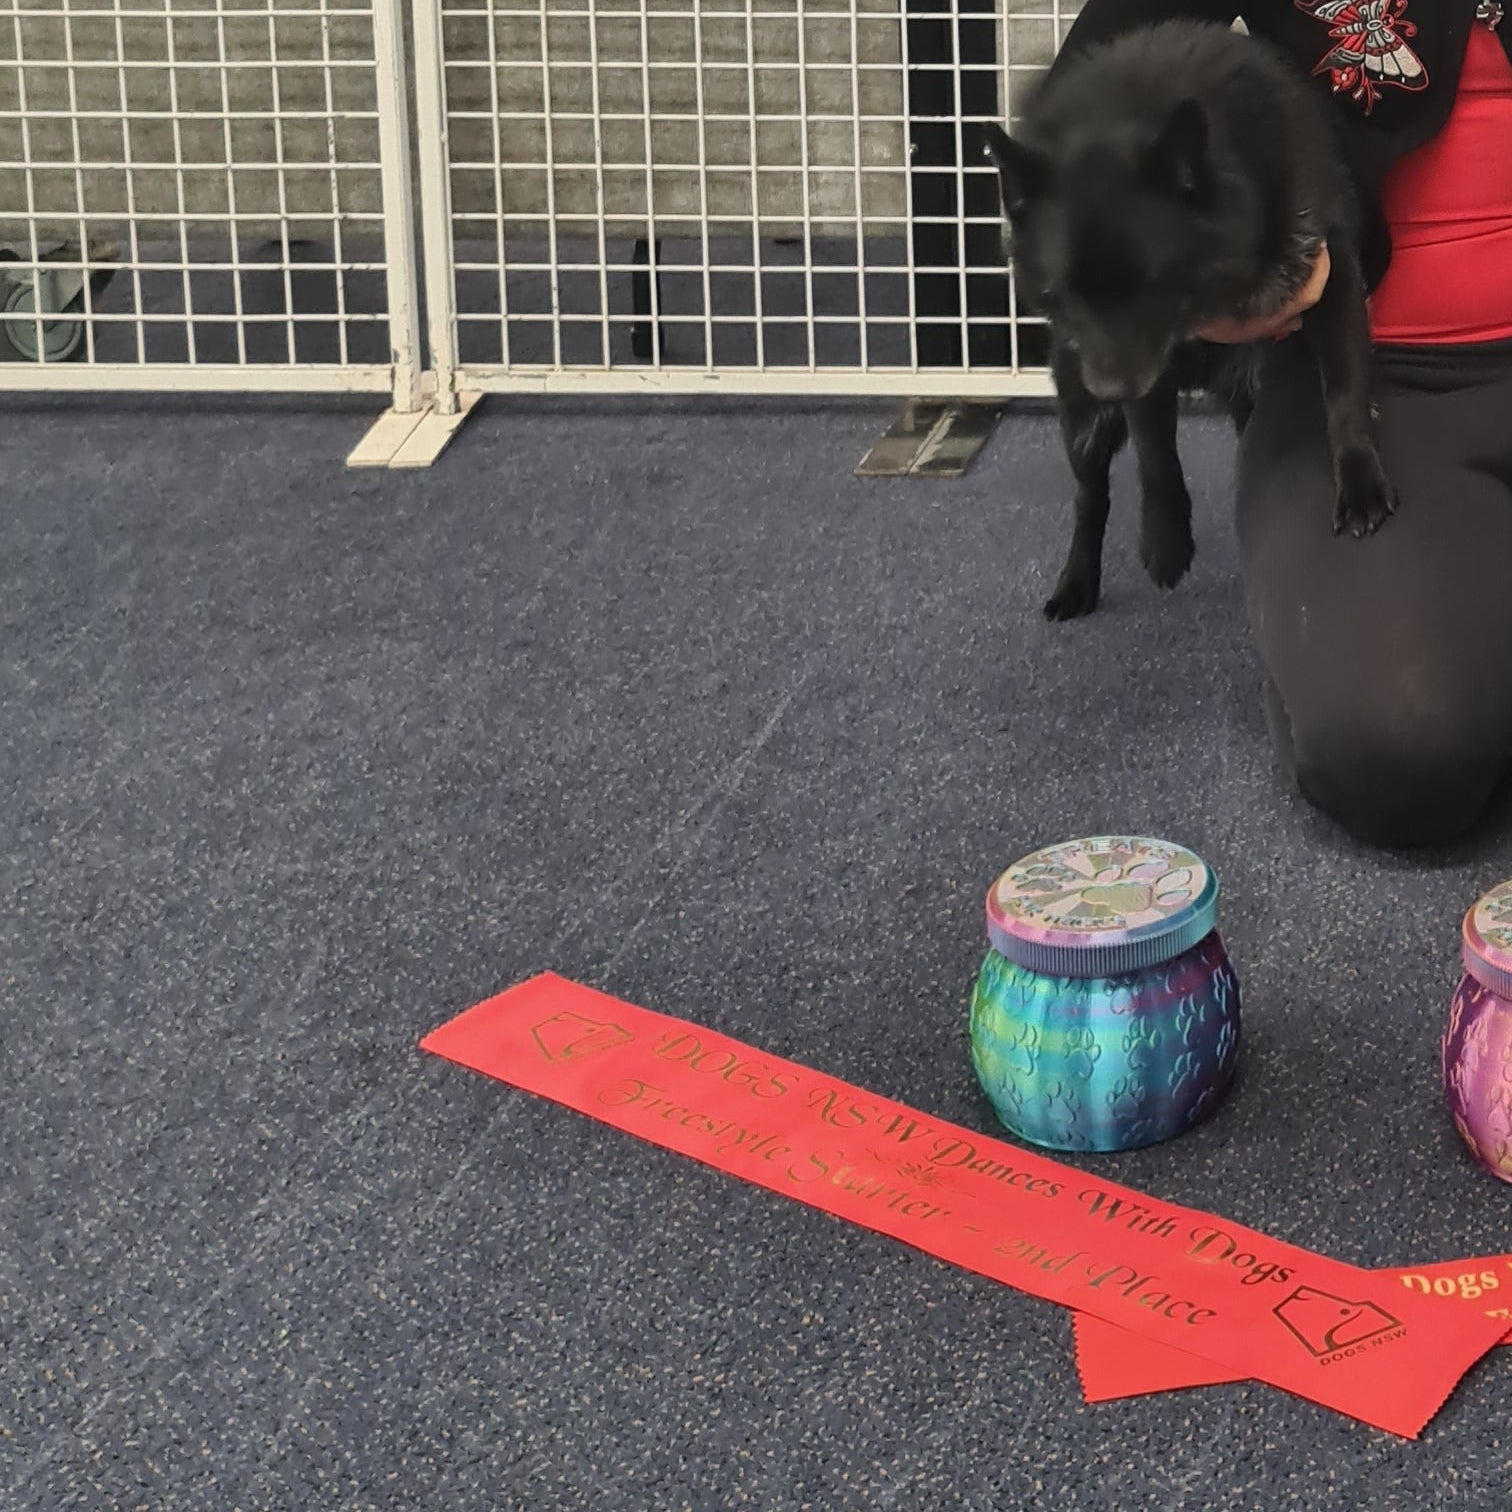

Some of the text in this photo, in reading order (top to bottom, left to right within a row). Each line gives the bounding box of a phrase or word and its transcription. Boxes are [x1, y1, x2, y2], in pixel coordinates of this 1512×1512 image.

[597, 1078, 792, 1161] Freestyle
[786, 1150, 953, 1220] Starter
[994, 1235, 1085, 1276] 2nd
[1087, 1257, 1219, 1327] Place
[652, 1032, 1297, 1287] DOGS NSW Dances With Dogs
[1319, 1345, 1368, 1367] DOGS
